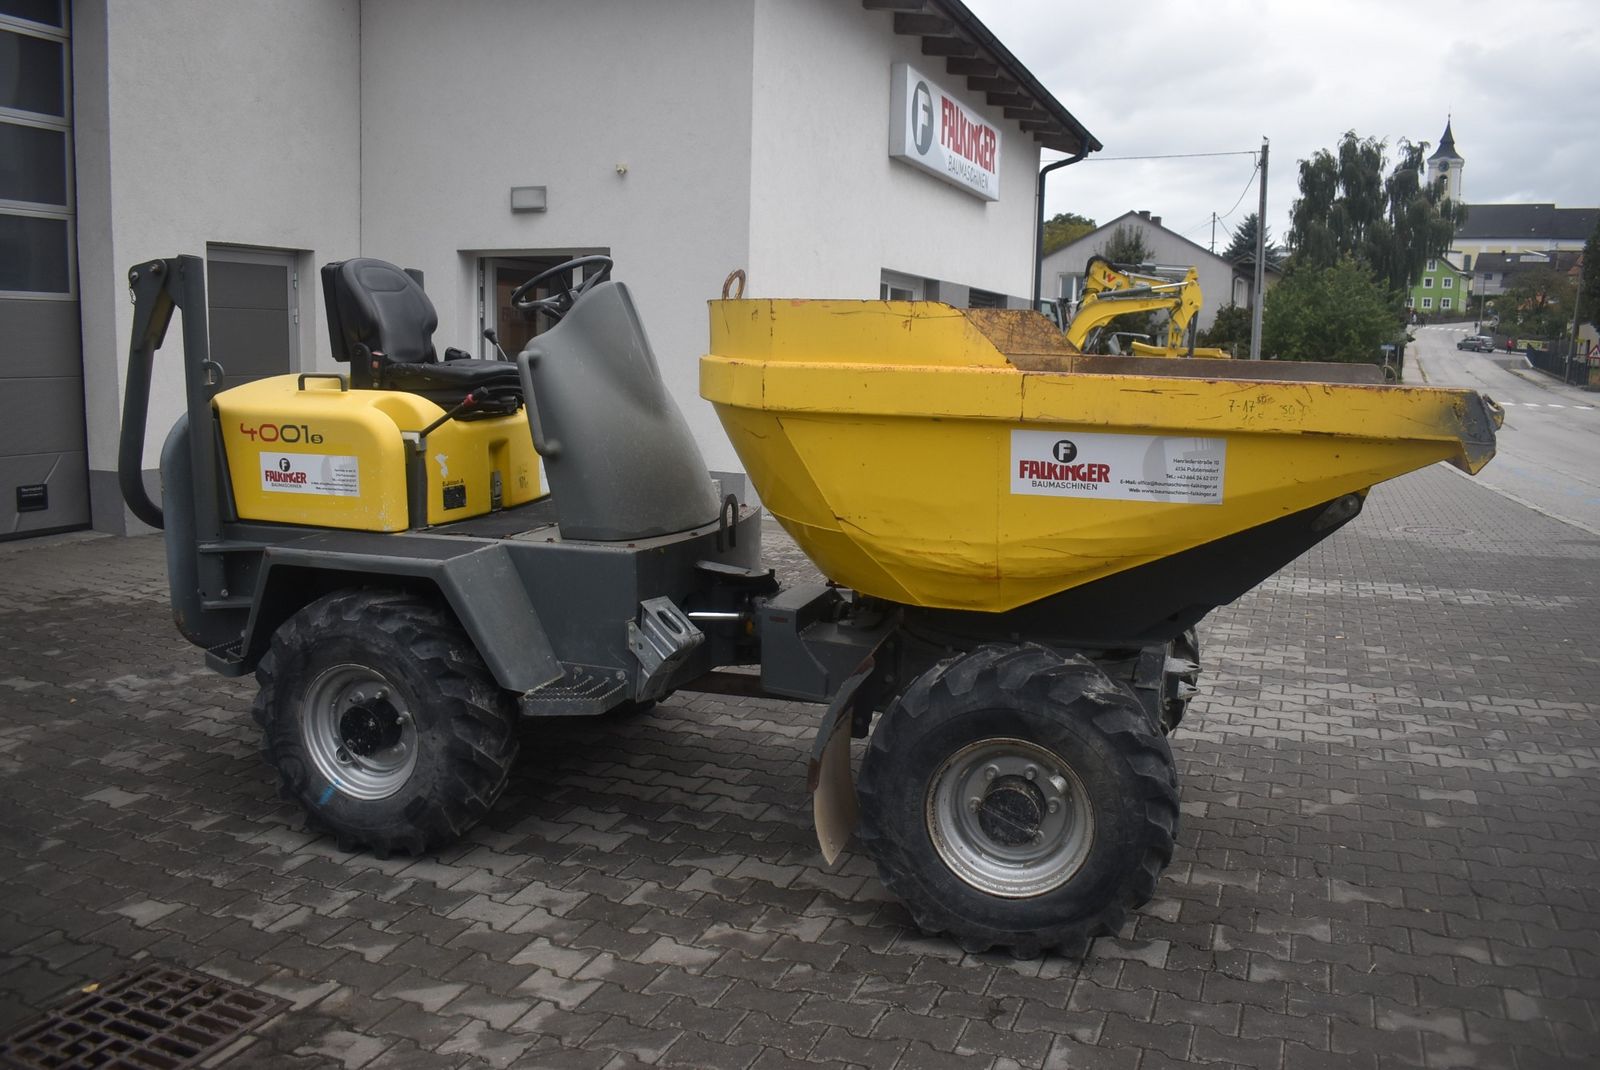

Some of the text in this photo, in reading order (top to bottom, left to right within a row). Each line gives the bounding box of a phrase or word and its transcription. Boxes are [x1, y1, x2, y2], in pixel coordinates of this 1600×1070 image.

[915, 86, 931, 149] F
[941, 95, 996, 175] FALKINGER
[948, 155, 989, 189] BAUMASCHINEN
[265, 470, 307, 484] FALKINGER
[1019, 460, 1110, 483] FALKINGER
[1031, 480, 1098, 491] BAUMASCHINEN
